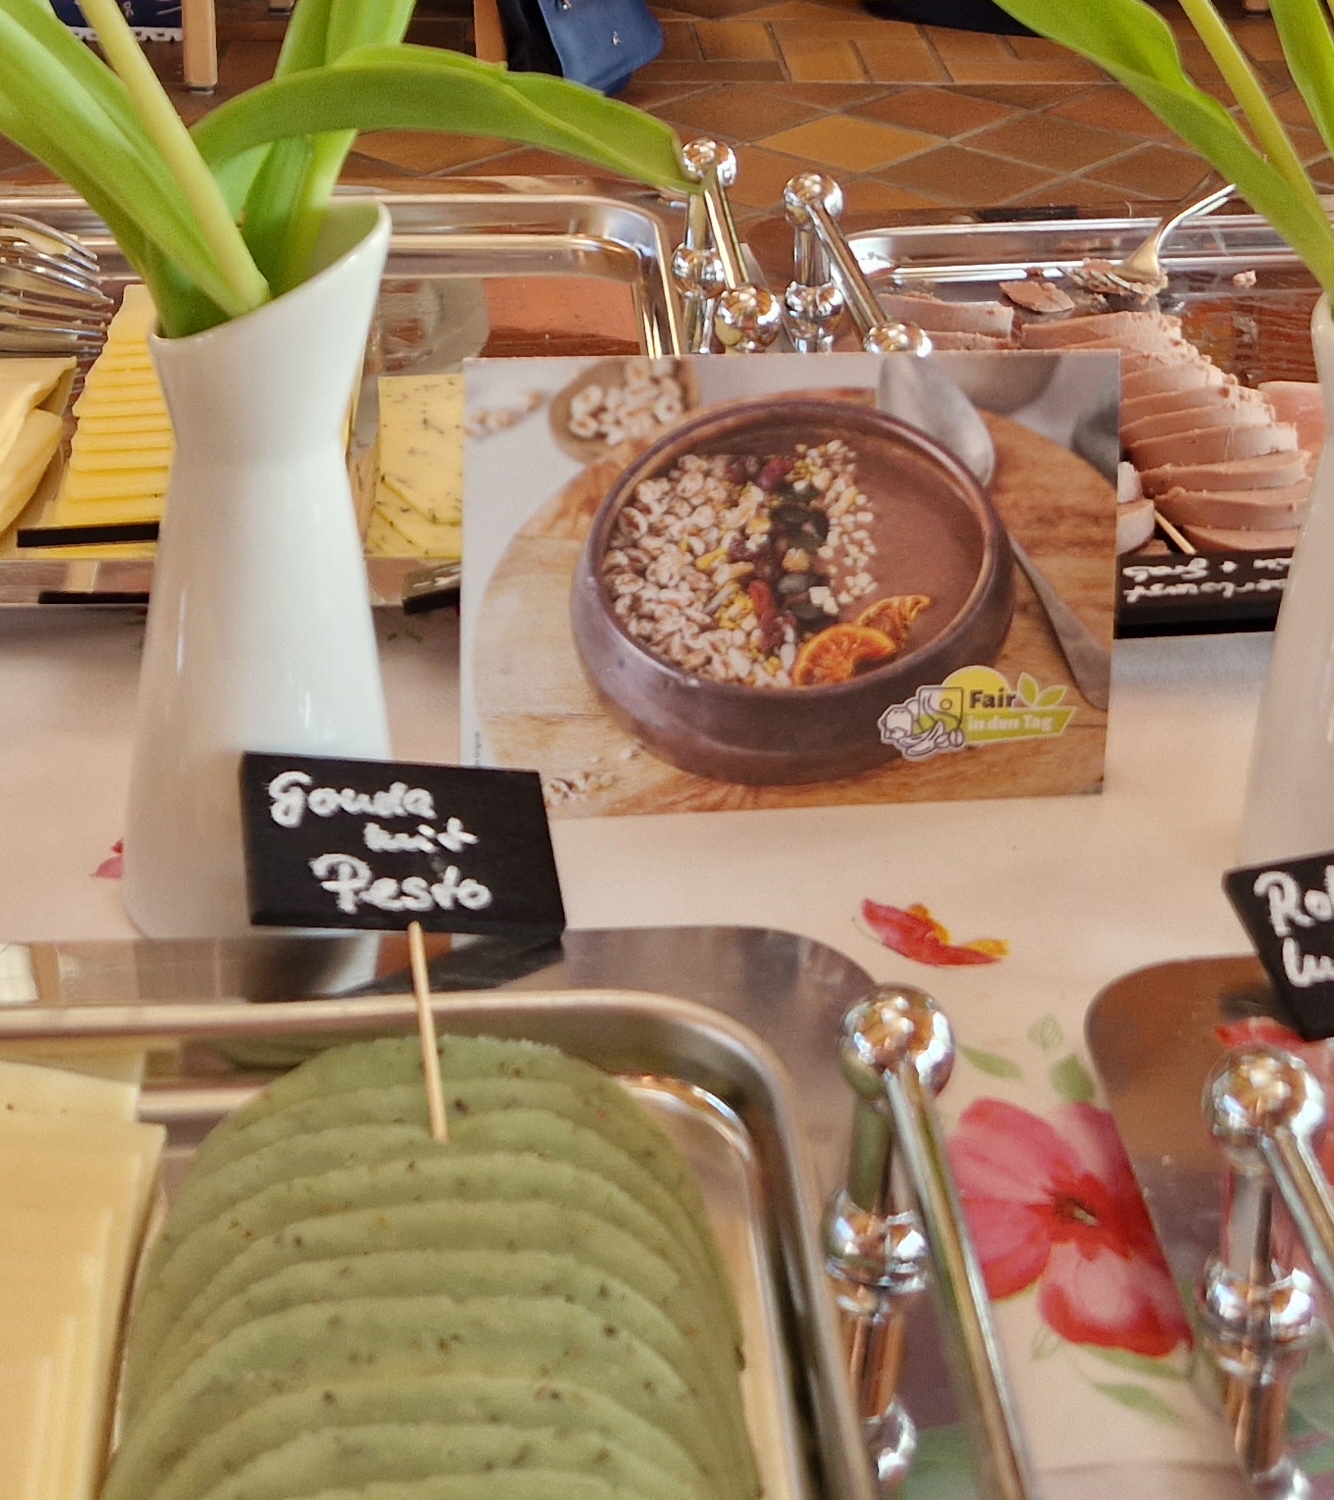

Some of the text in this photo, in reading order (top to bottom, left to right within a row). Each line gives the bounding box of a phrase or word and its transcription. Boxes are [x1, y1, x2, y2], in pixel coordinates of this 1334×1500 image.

[970, 688, 1017, 708] Fair
[969, 714, 1053, 731] in den Tag
[267, 771, 437, 828] Gouda
[363, 817, 479, 853] mit
[308, 853, 493, 914] Pesto
